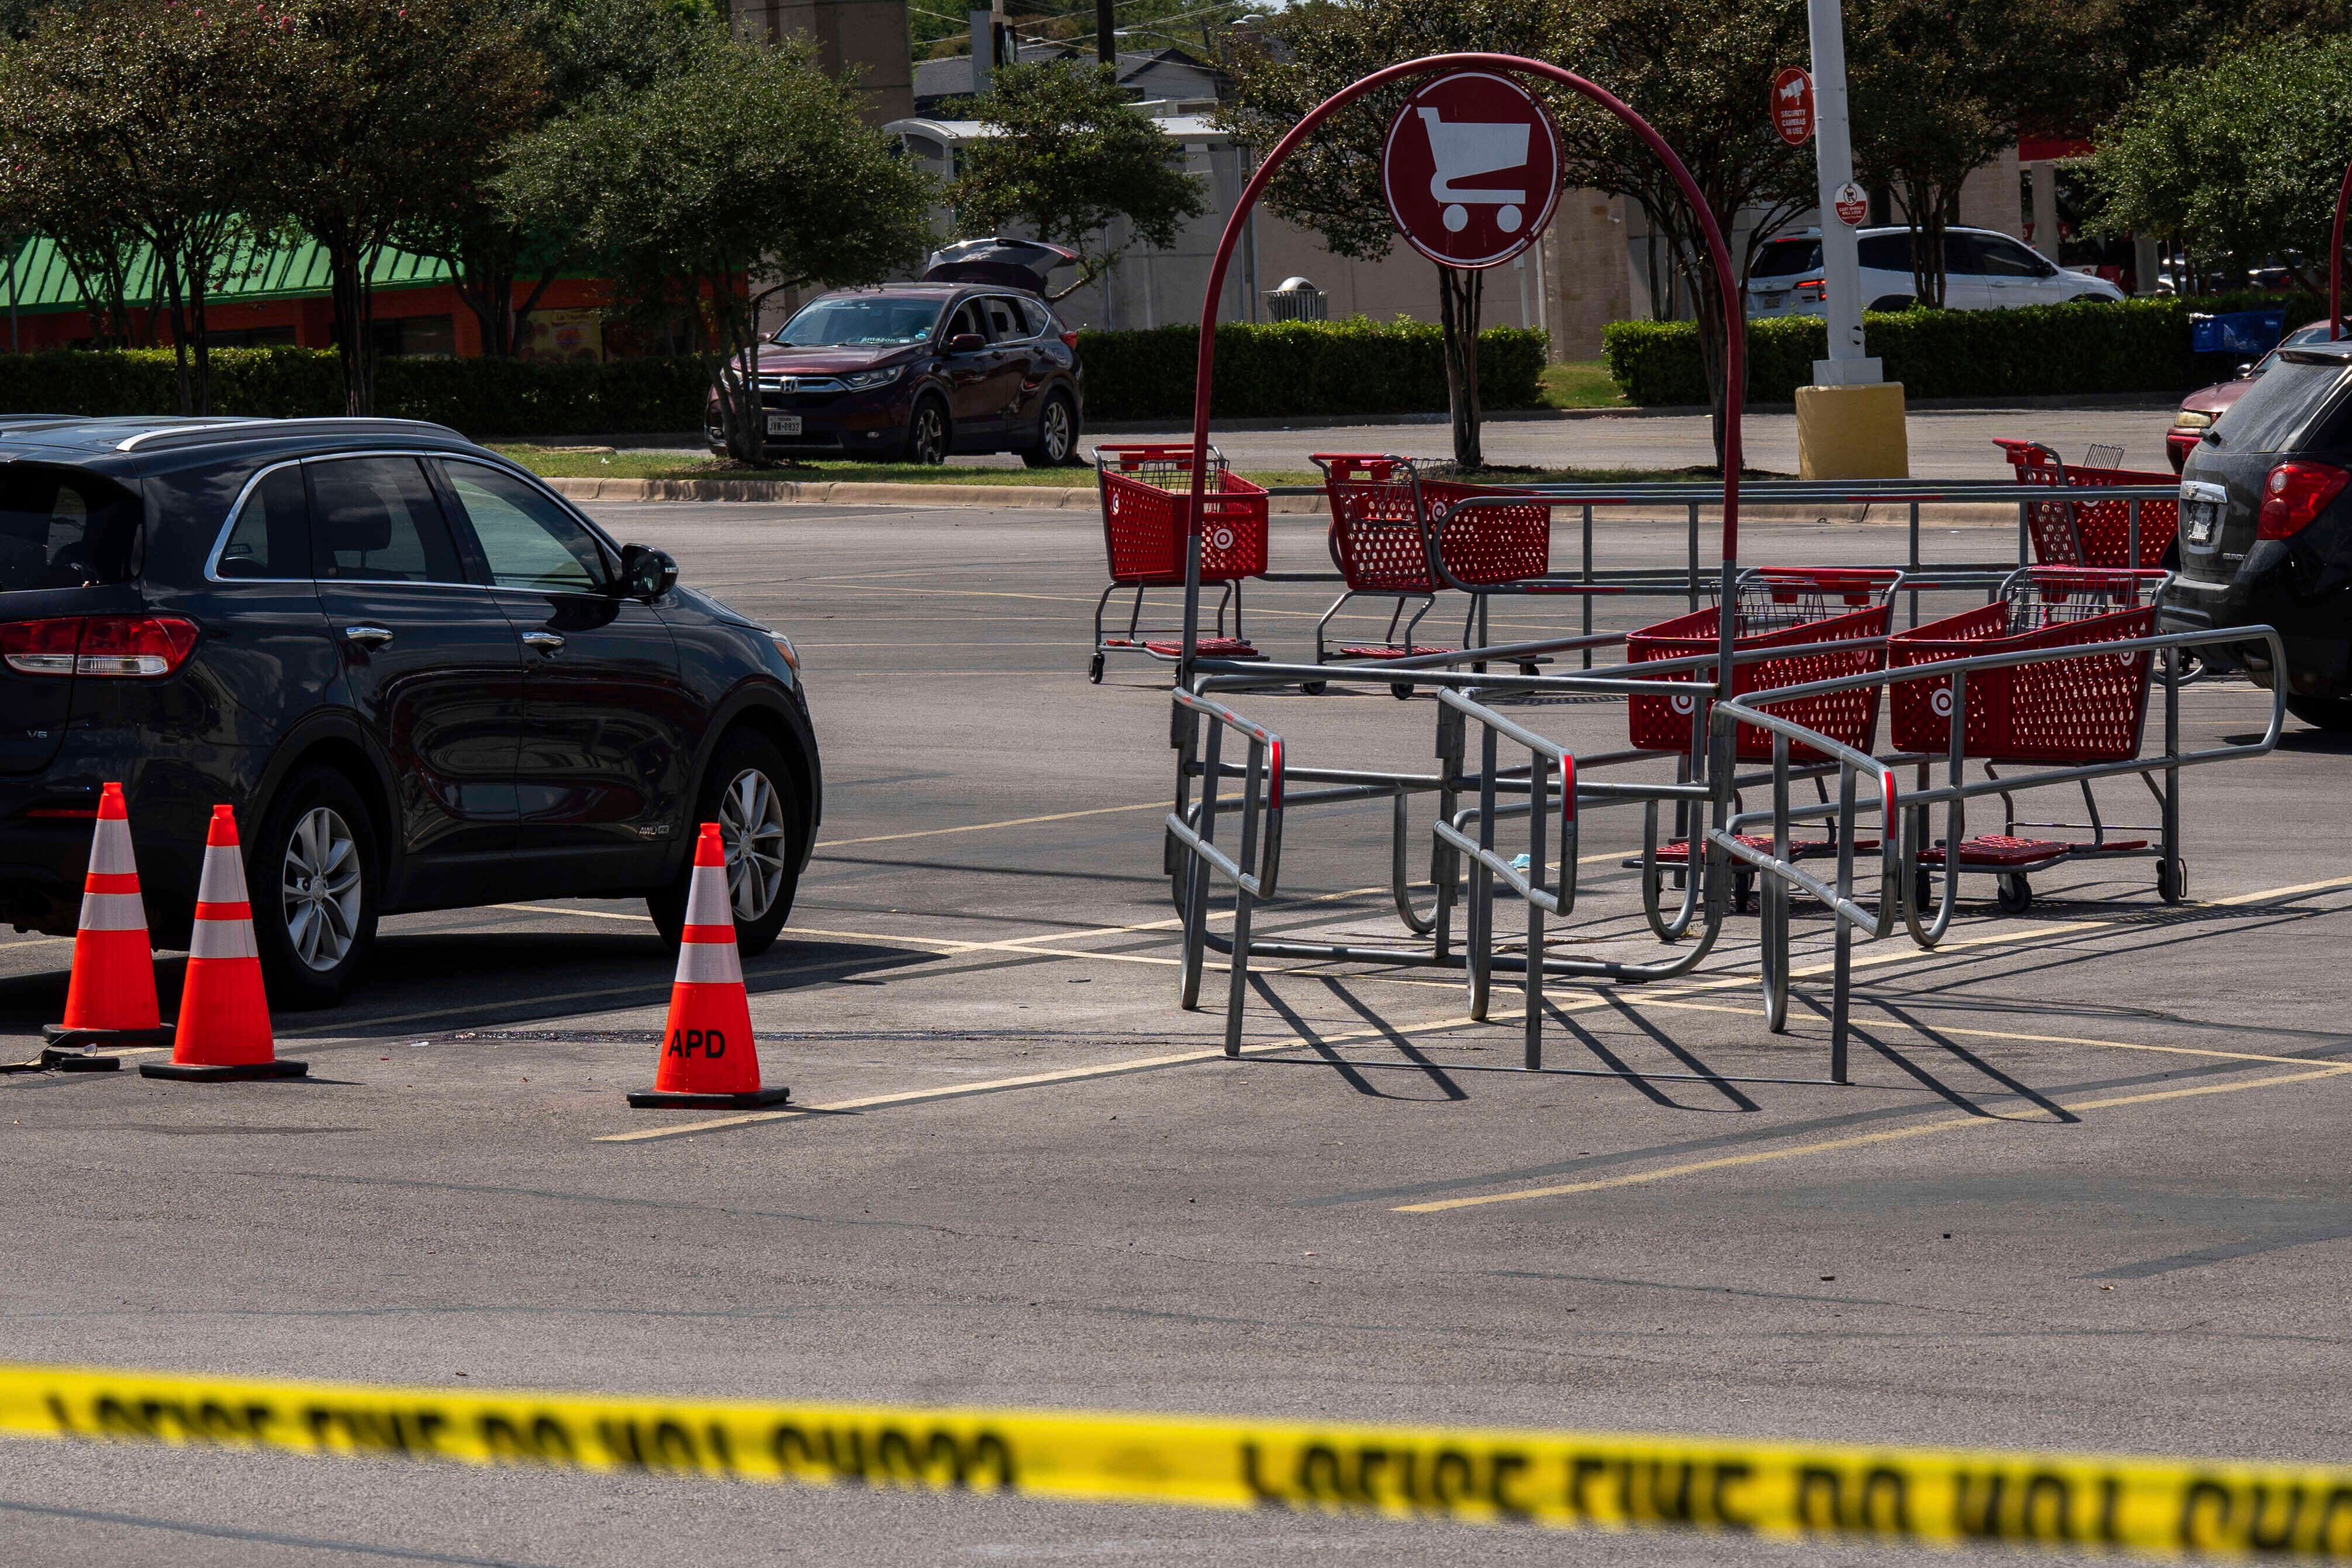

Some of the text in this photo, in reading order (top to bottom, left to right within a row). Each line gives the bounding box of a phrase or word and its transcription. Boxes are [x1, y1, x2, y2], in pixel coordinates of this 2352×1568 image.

[1781, 109, 1806, 118] SECURITY
[1781, 118, 1806, 127] CAMERAS
[2022, 228, 2028, 238] 3
[2061, 226, 2067, 234] 4
[26, 730, 47, 739] V6
[638, 827, 657, 835] AWD
[668, 1028, 726, 1059] APD
